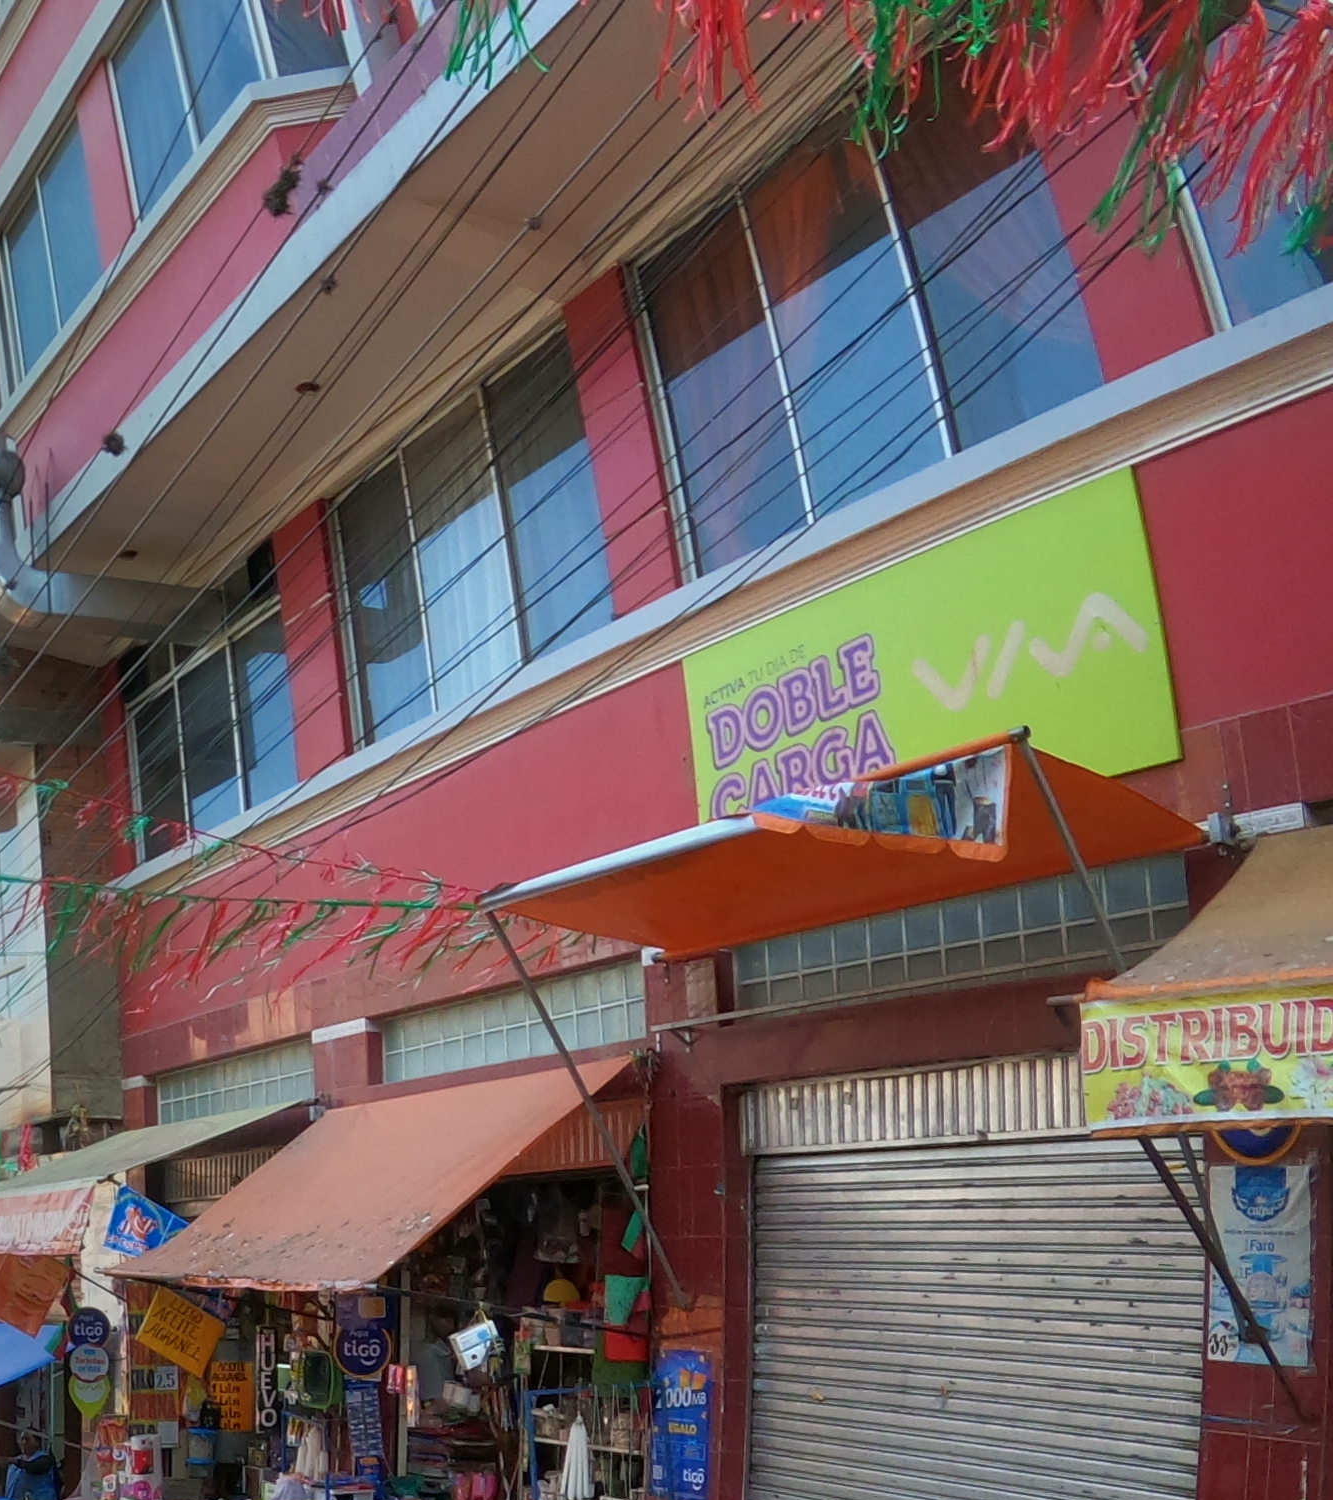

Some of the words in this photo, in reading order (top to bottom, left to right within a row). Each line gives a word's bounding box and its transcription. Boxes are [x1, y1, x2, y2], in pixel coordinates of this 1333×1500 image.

[703, 677, 747, 709] ACTIVA
[747, 666, 764, 685] TU
[791, 644, 808, 665] DE
[706, 633, 881, 770] DOBLE
[709, 709, 898, 820] CARGA
[1081, 997, 1333, 1076] DISTRIBUID
[74, 1322, 103, 1343] tigo
[151, 1306, 202, 1341] ACEITE
[344, 1339, 382, 1366] tigo
[260, 1333, 278, 1428] HUEVO
[683, 1468, 705, 1491] tigo
